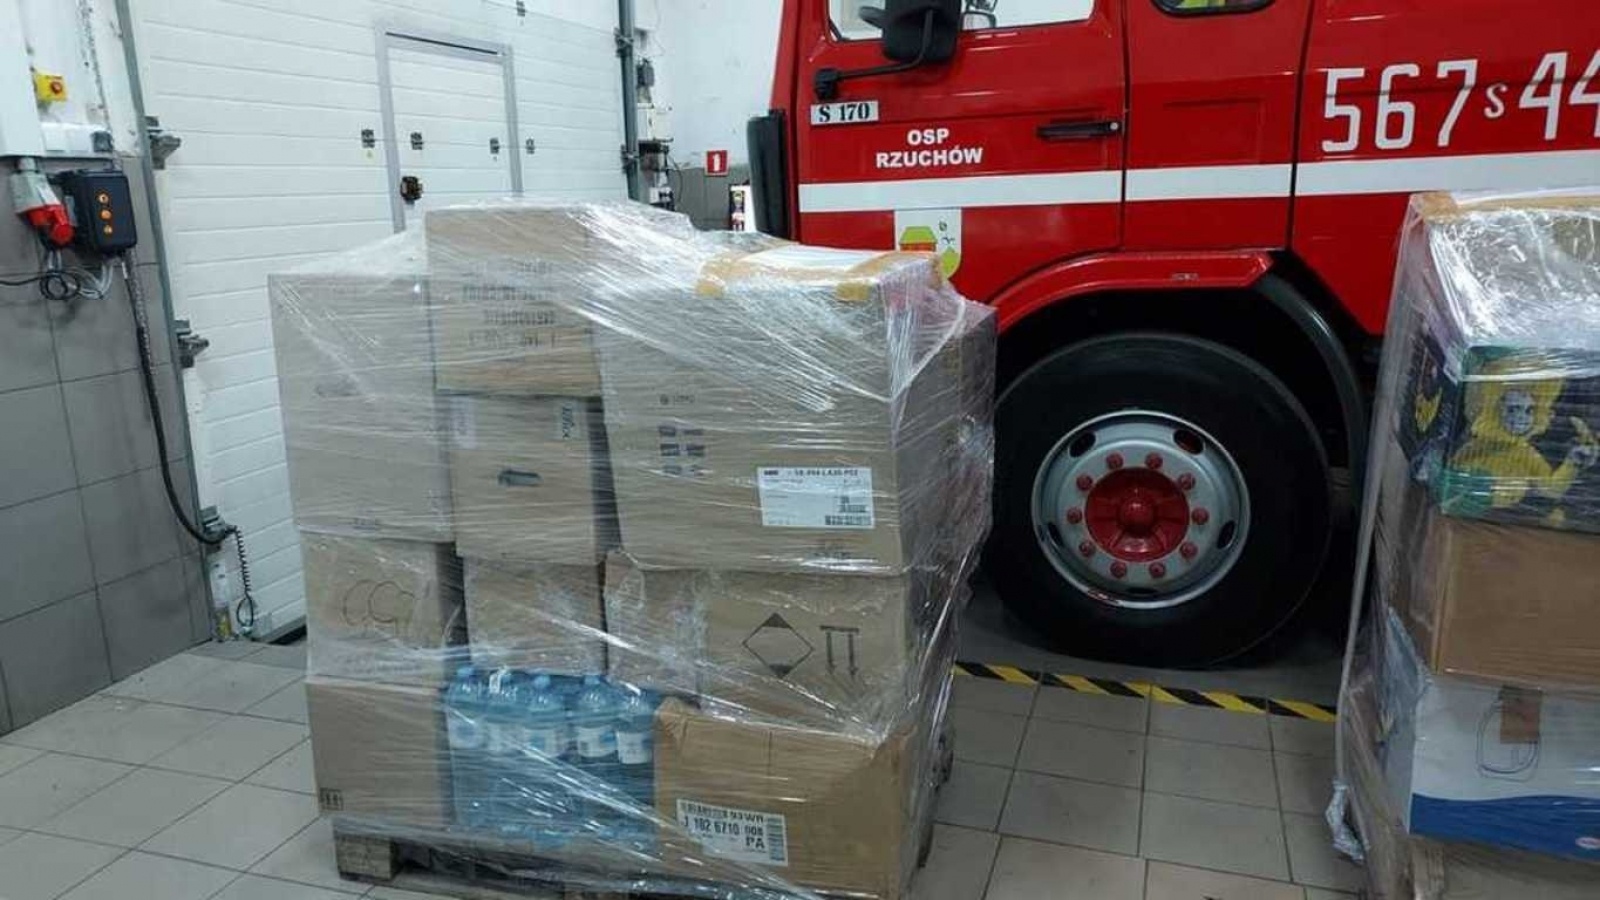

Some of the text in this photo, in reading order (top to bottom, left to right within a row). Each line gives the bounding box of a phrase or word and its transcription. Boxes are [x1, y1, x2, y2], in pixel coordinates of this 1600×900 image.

[819, 103, 870, 123] S 170
[907, 128, 949, 146] OSP
[876, 146, 983, 169] RZUCHÓW
[745, 836, 765, 850] PA
